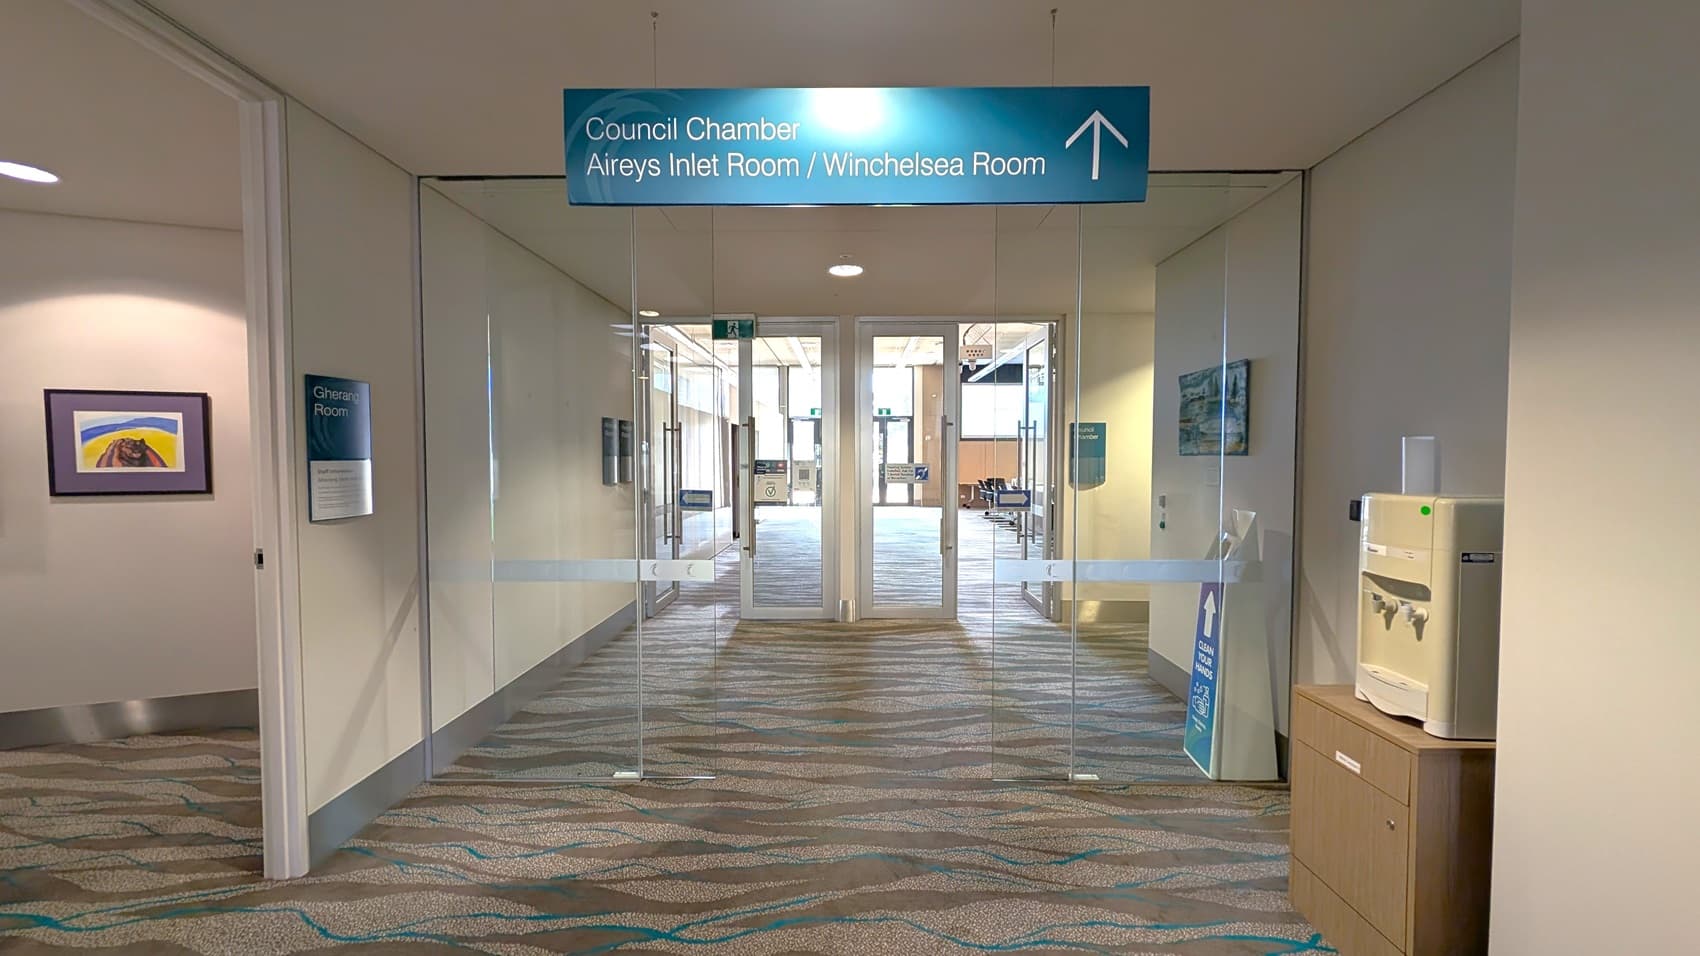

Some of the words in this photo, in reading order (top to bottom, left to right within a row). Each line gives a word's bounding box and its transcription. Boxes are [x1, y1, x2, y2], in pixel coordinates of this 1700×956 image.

[586, 117, 677, 142] Council
[686, 116, 800, 141] Chamber
[586, 152, 661, 182] Aireys
[669, 151, 720, 177] Inlet
[726, 152, 800, 177] Room
[823, 151, 965, 177] Winchelsea
[972, 151, 1046, 176] Room
[313, 385, 360, 405] Gherang
[314, 403, 349, 417] Room
[1073, 425, 1095, 433] ouncil
[1198, 641, 1214, 657] CLEAN
[1198, 651, 1213, 667] YOUR
[1195, 661, 1213, 680] HANDS
